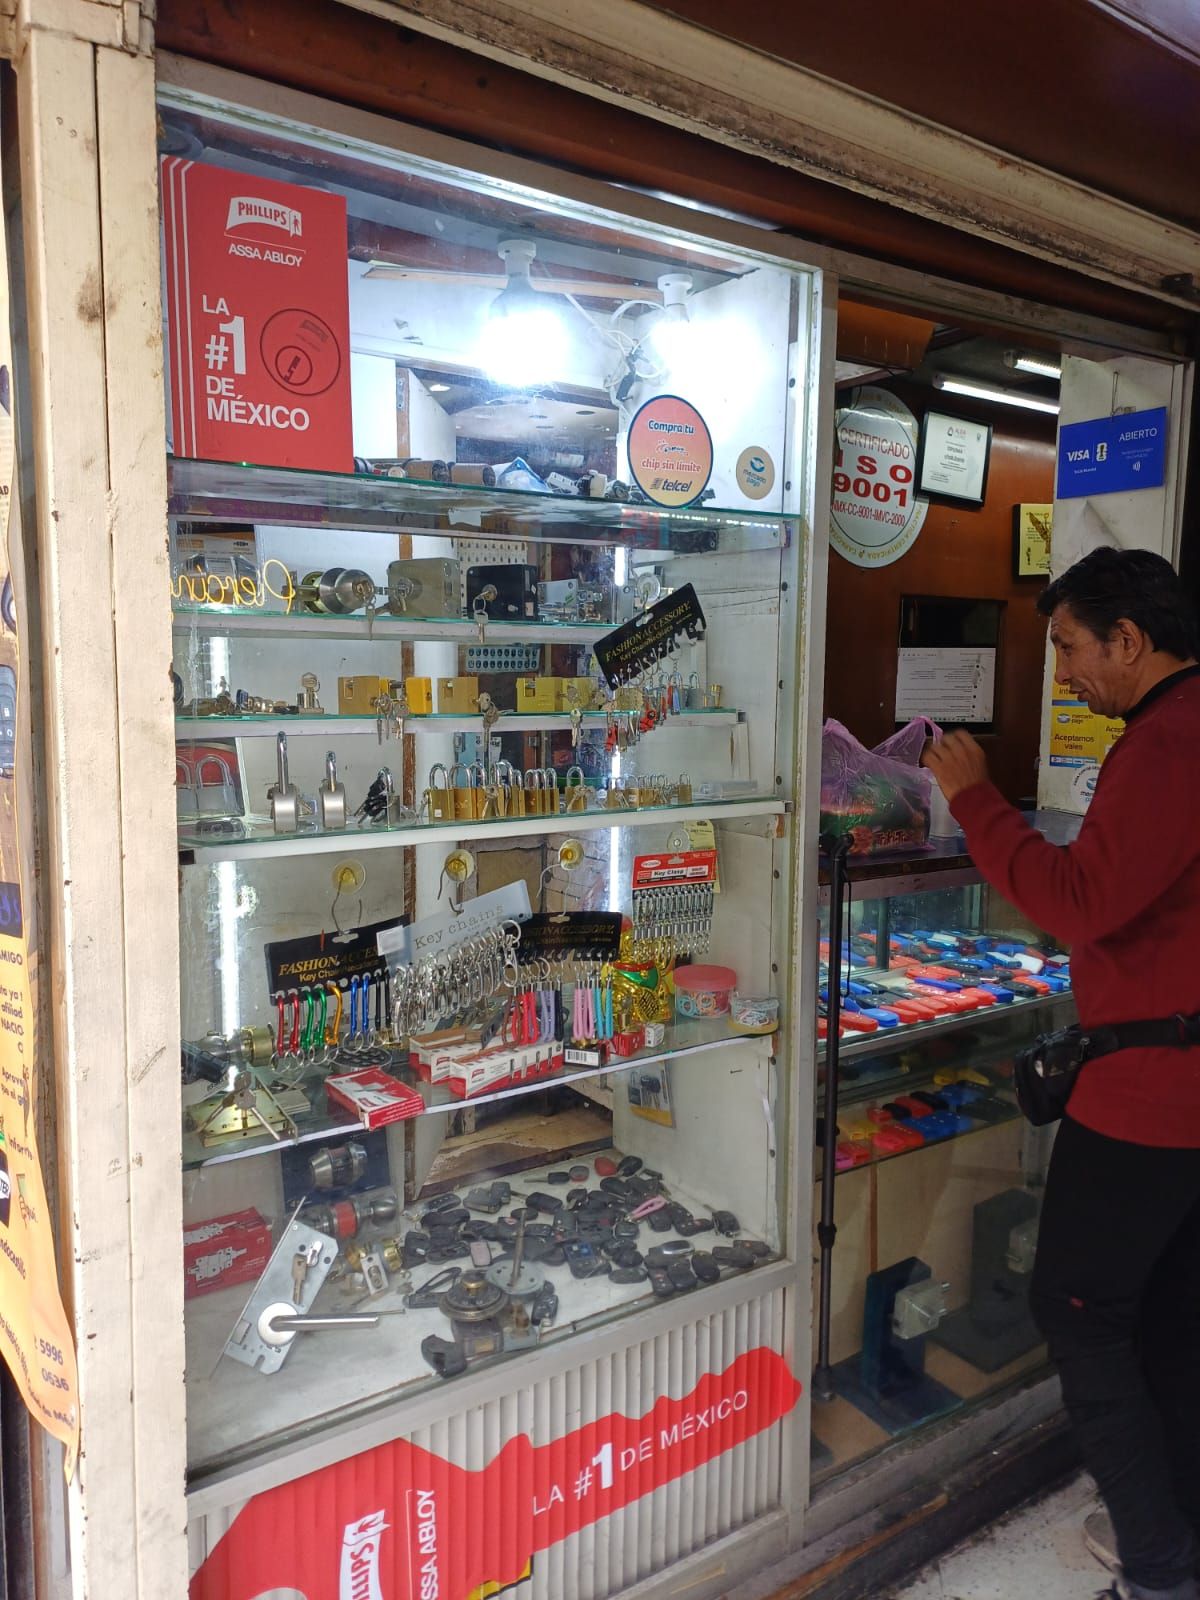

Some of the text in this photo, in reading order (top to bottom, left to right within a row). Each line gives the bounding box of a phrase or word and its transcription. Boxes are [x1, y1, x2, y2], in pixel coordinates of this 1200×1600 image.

[237, 201, 287, 226] PHILLIPS
[228, 242, 303, 267] ASSA ABLOY
[202, 294, 230, 316] LA
[204, 315, 247, 376] #1
[206, 375, 235, 395] DE
[207, 395, 310, 431] MÉXICO
[648, 420, 695, 434] Compra tu
[1119, 427, 1158, 442] ABIERTO
[839, 427, 910, 460] CERTIFICADO
[641, 459, 661, 471] chip
[662, 460, 676, 471] sin
[1066, 449, 1090, 462] VISA
[661, 479, 693, 493] telcel
[833, 472, 908, 508] 9001
[605, 630, 641, 663] FASHION
[619, 651, 632, 663] Key
[1054, 732, 1095, 743] Aceptamos
[1064, 741, 1084, 751] vales
[415, 904, 504, 950] Key chains
[0, 949, 23, 966] MIGO
[278, 954, 339, 977] FASHION
[299, 972, 317, 983] Key
[39, 1338, 64, 1366] 5996
[532, 1390, 748, 1516] LA #1 DE MÉXICO
[416, 1489, 439, 1600] SSA ABLOY
[350, 1542, 375, 1600] ILLIPS
